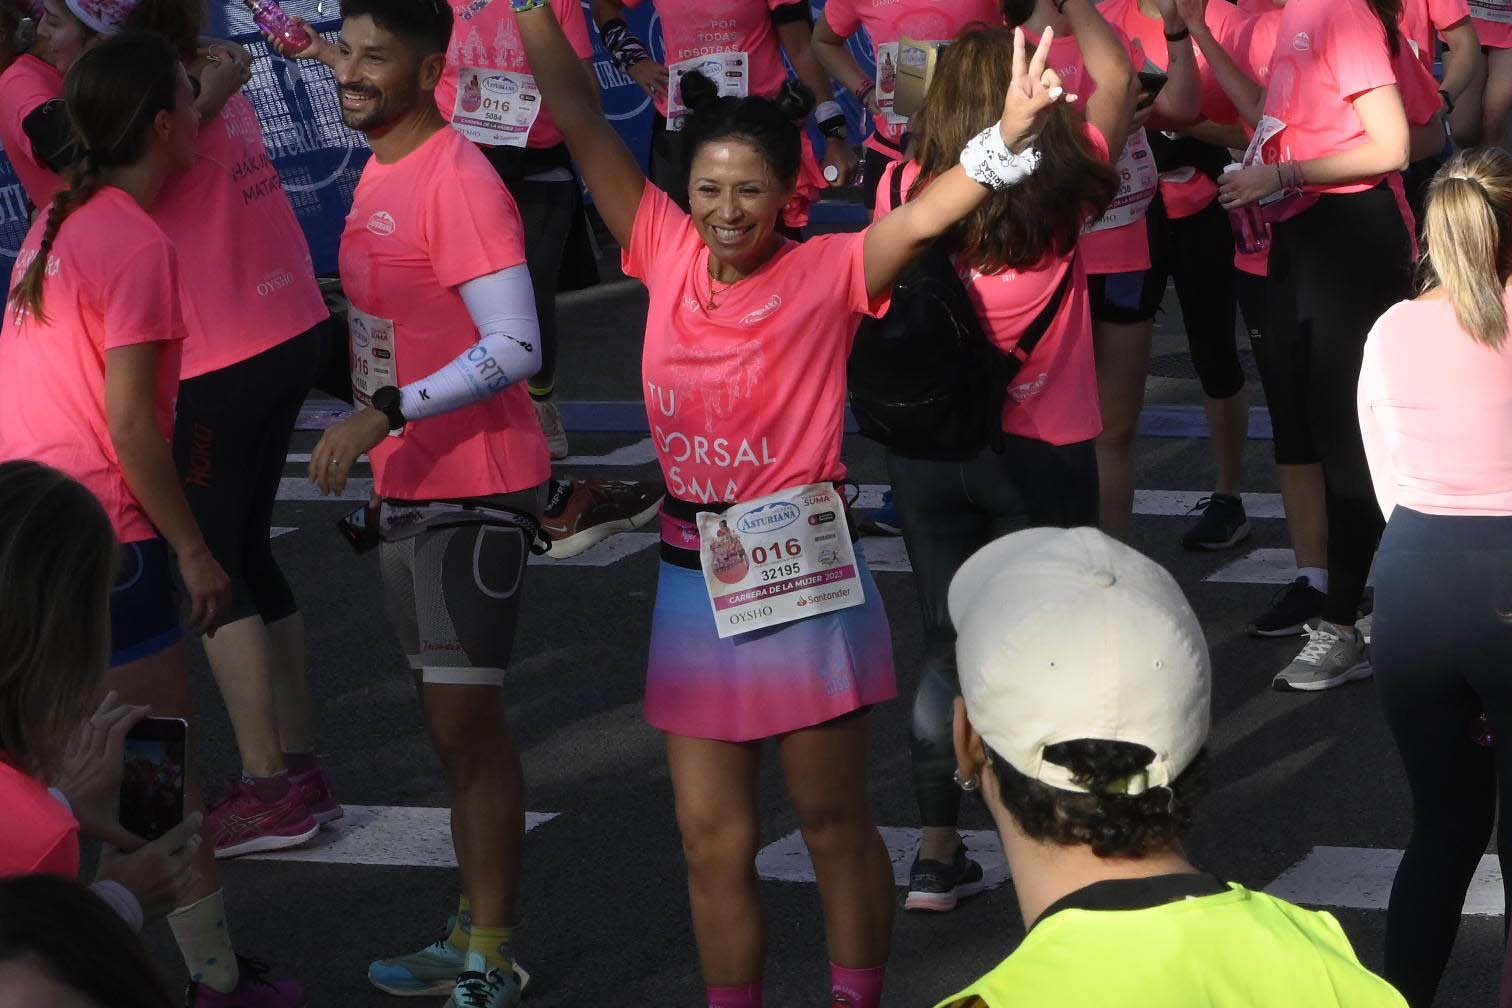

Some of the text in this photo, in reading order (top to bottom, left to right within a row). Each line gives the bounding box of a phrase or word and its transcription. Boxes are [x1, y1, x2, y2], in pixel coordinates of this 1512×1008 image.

[711, 19, 737, 29] POR
[699, 32, 737, 41] TODAS
[483, 98, 510, 112] 016
[257, 273, 293, 296] OYSHO
[648, 380, 674, 417] TU
[803, 495, 831, 507] SUMA
[742, 509, 797, 531] ASTURIANA
[752, 538, 802, 565] 016
[761, 563, 801, 582] 32195
[729, 571, 844, 605] CARRERA DE LA MUJER 2023
[808, 588, 851, 605] Santander
[730, 605, 773, 625] OYSHO
